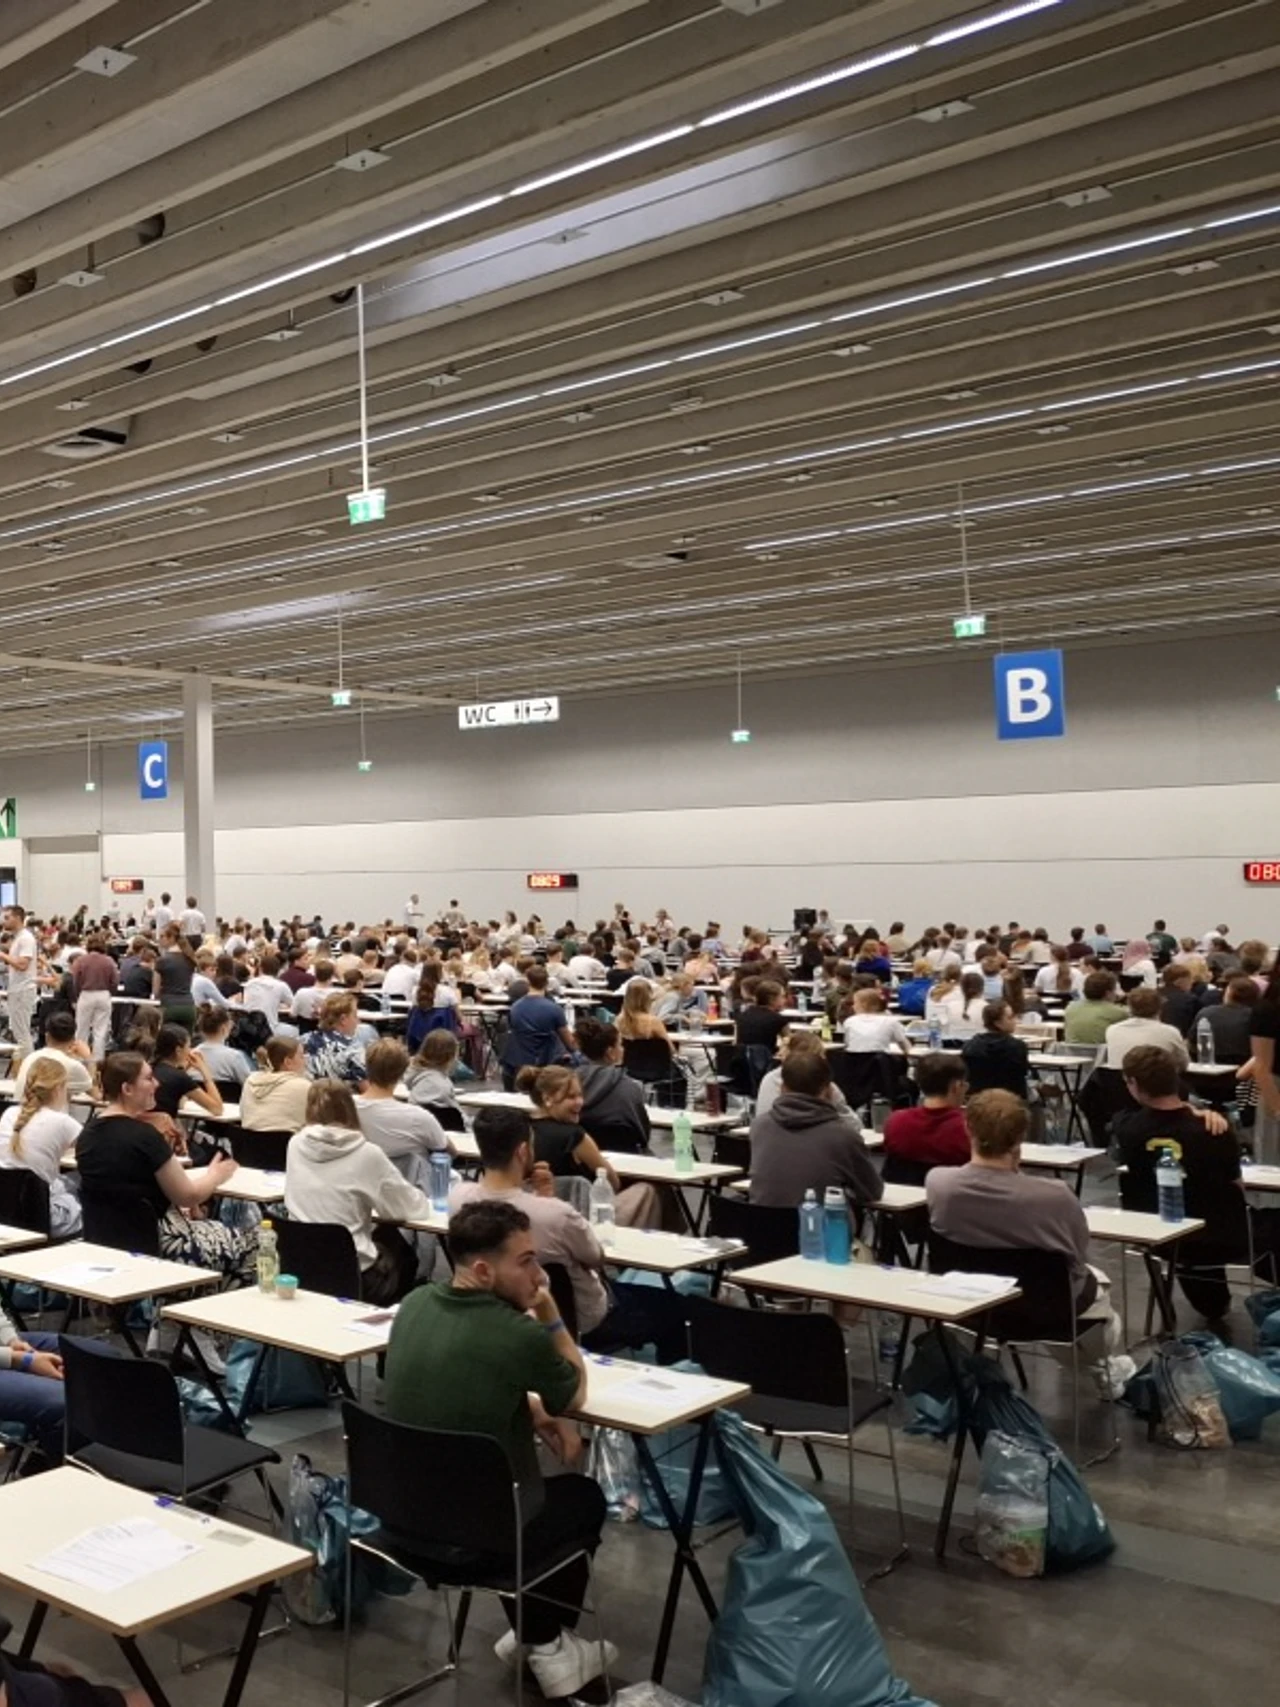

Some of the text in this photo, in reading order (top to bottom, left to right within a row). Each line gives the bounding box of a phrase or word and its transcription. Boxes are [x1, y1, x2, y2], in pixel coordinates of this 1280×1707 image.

[1006, 667, 1052, 724] B
[464, 706, 496, 724] WC
[144, 753, 163, 788] C
